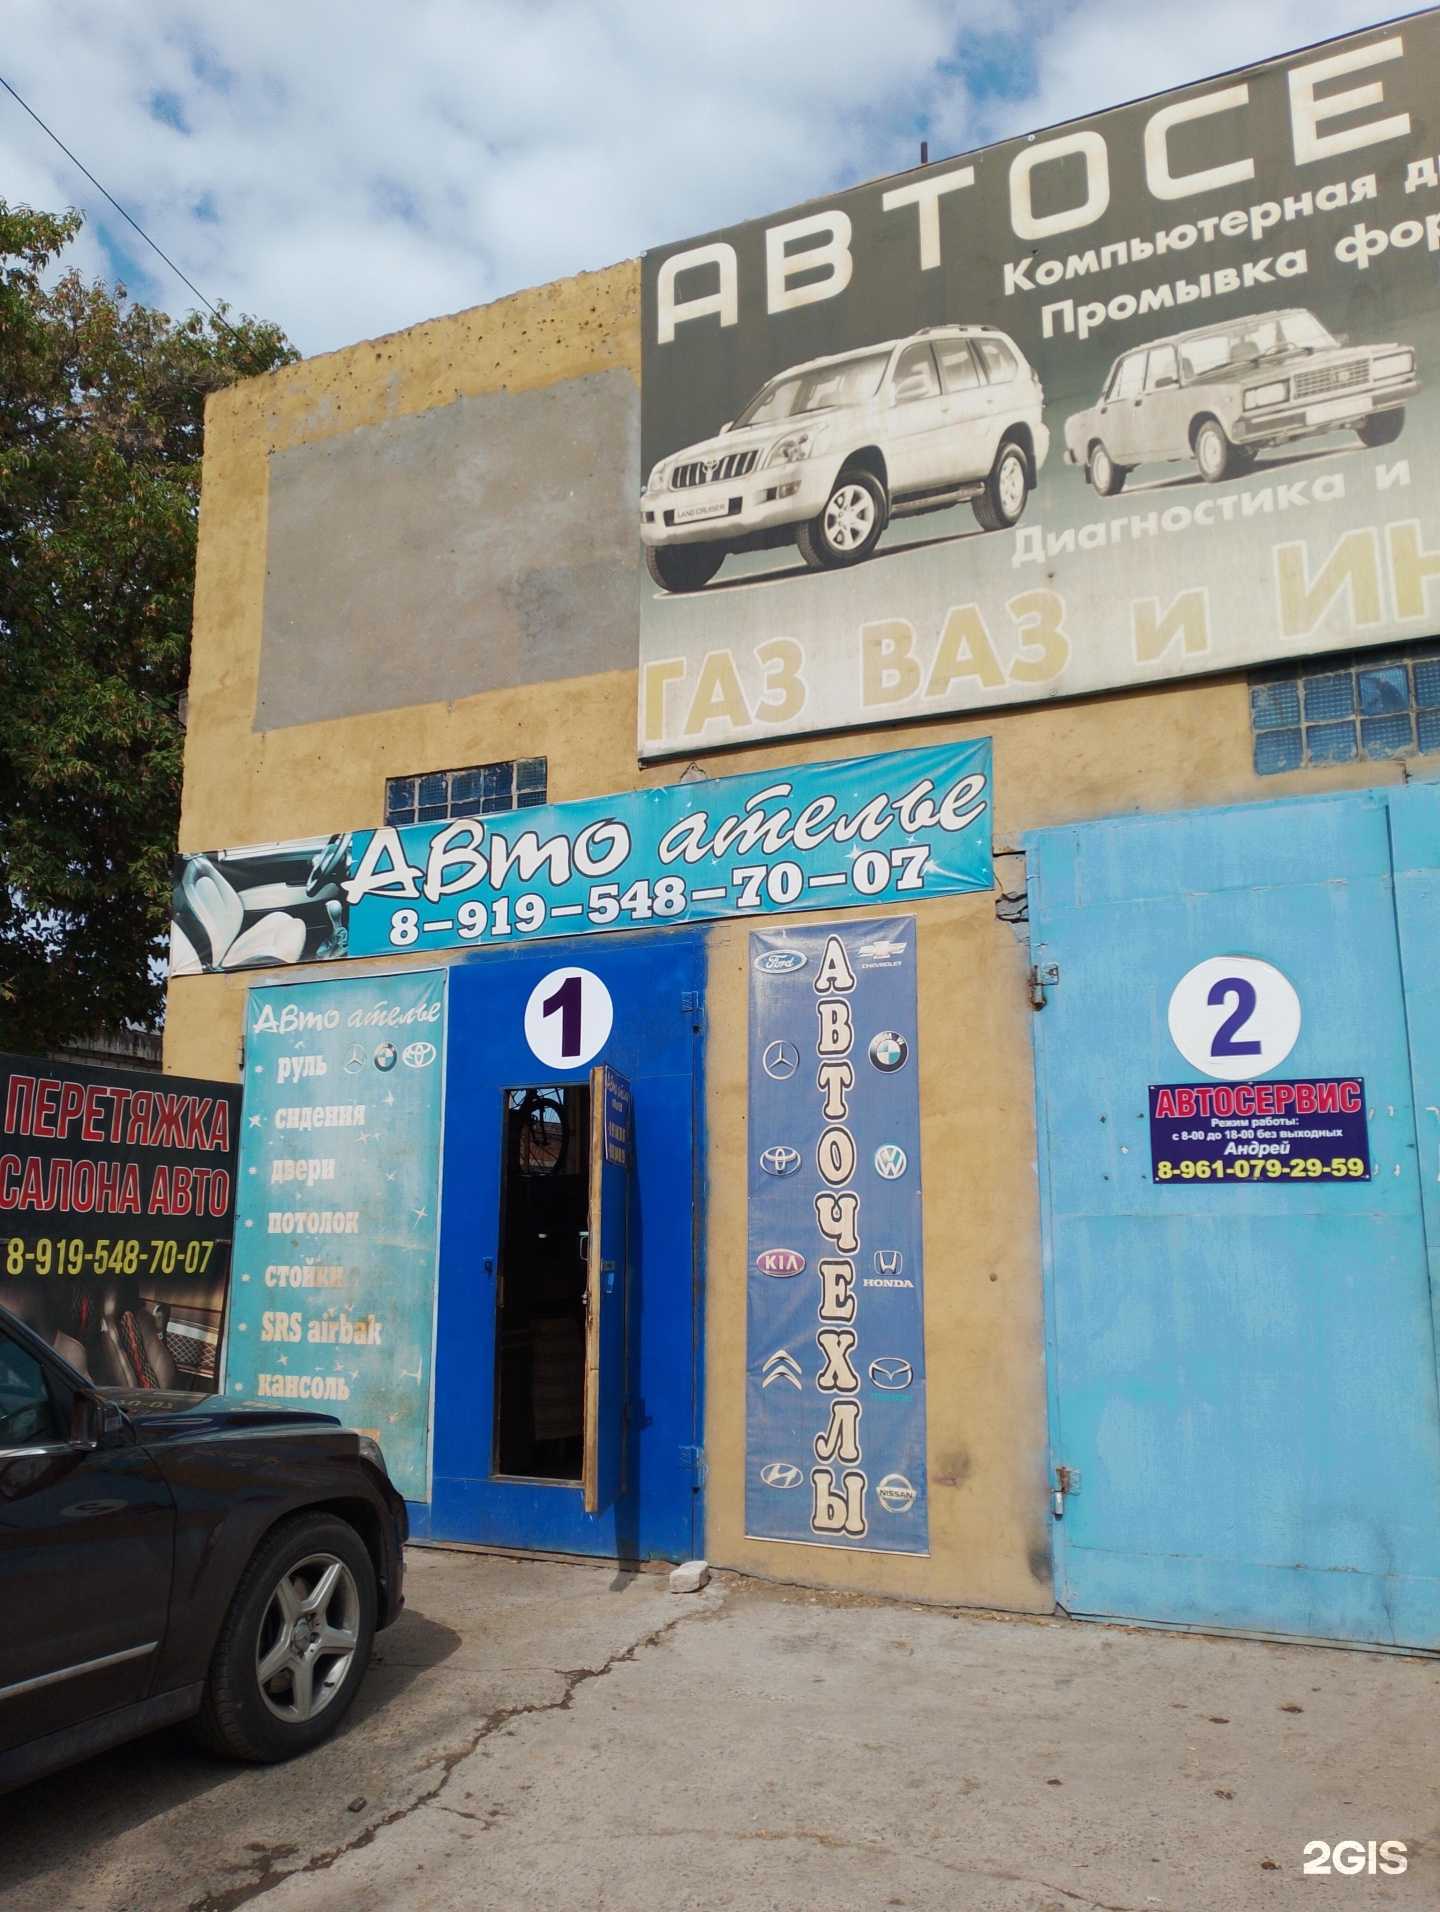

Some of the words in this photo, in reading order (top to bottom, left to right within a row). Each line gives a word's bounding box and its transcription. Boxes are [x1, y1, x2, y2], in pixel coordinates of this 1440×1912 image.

[1003, 173, 1378, 297] Компьютерная
[1405, 152, 1440, 194] д
[1042, 248, 1309, 340] Промывка
[1011, 468, 1347, 568] Диагностика
[1376, 460, 1411, 489] и
[641, 637, 809, 743] ГАЗ
[860, 589, 1071, 709] ВАЗ
[1131, 585, 1210, 665] и
[658, 773, 989, 866] ателье
[765, 953, 794, 968] Ford
[348, 1000, 442, 1030] ателье
[543, 976, 582, 1058] 1
[1207, 977, 1263, 1057] 2
[277, 1052, 328, 1083] руль
[4, 1074, 231, 1153] ПЕРЕТЯЖКА
[1155, 1082, 1362, 1118] АВТОСЕРВИС
[275, 1104, 366, 1131] сидения
[1211, 1118, 1249, 1128] Режим
[1252, 1117, 1300, 1129] работы:
[1181, 1131, 1205, 1141] 8-00
[1207, 1133, 1222, 1142] до
[1225, 1130, 1254, 1140] 18-00
[1257, 1129, 1277, 1139] без
[1280, 1129, 1343, 1140] выходных
[1224, 1141, 1291, 1157] Андрей
[271, 1158, 336, 1185] двери
[1158, 1158, 1364, 1179] 8-961-079-29-59
[0, 1154, 142, 1215] САЛОНА
[149, 1166, 231, 1218] АВТО
[268, 1211, 360, 1234] потолок
[811, 935, 868, 1537] АВТОЧЕХЛЫ
[6, 1238, 214, 1276] 8-919-548-70-07
[764, 1254, 797, 1271] KIA
[863, 1278, 914, 1288] HONDA
[261, 1311, 302, 1343] SRS
[258, 1373, 350, 1401] кансоль
[880, 1489, 913, 1499] NISSAN
